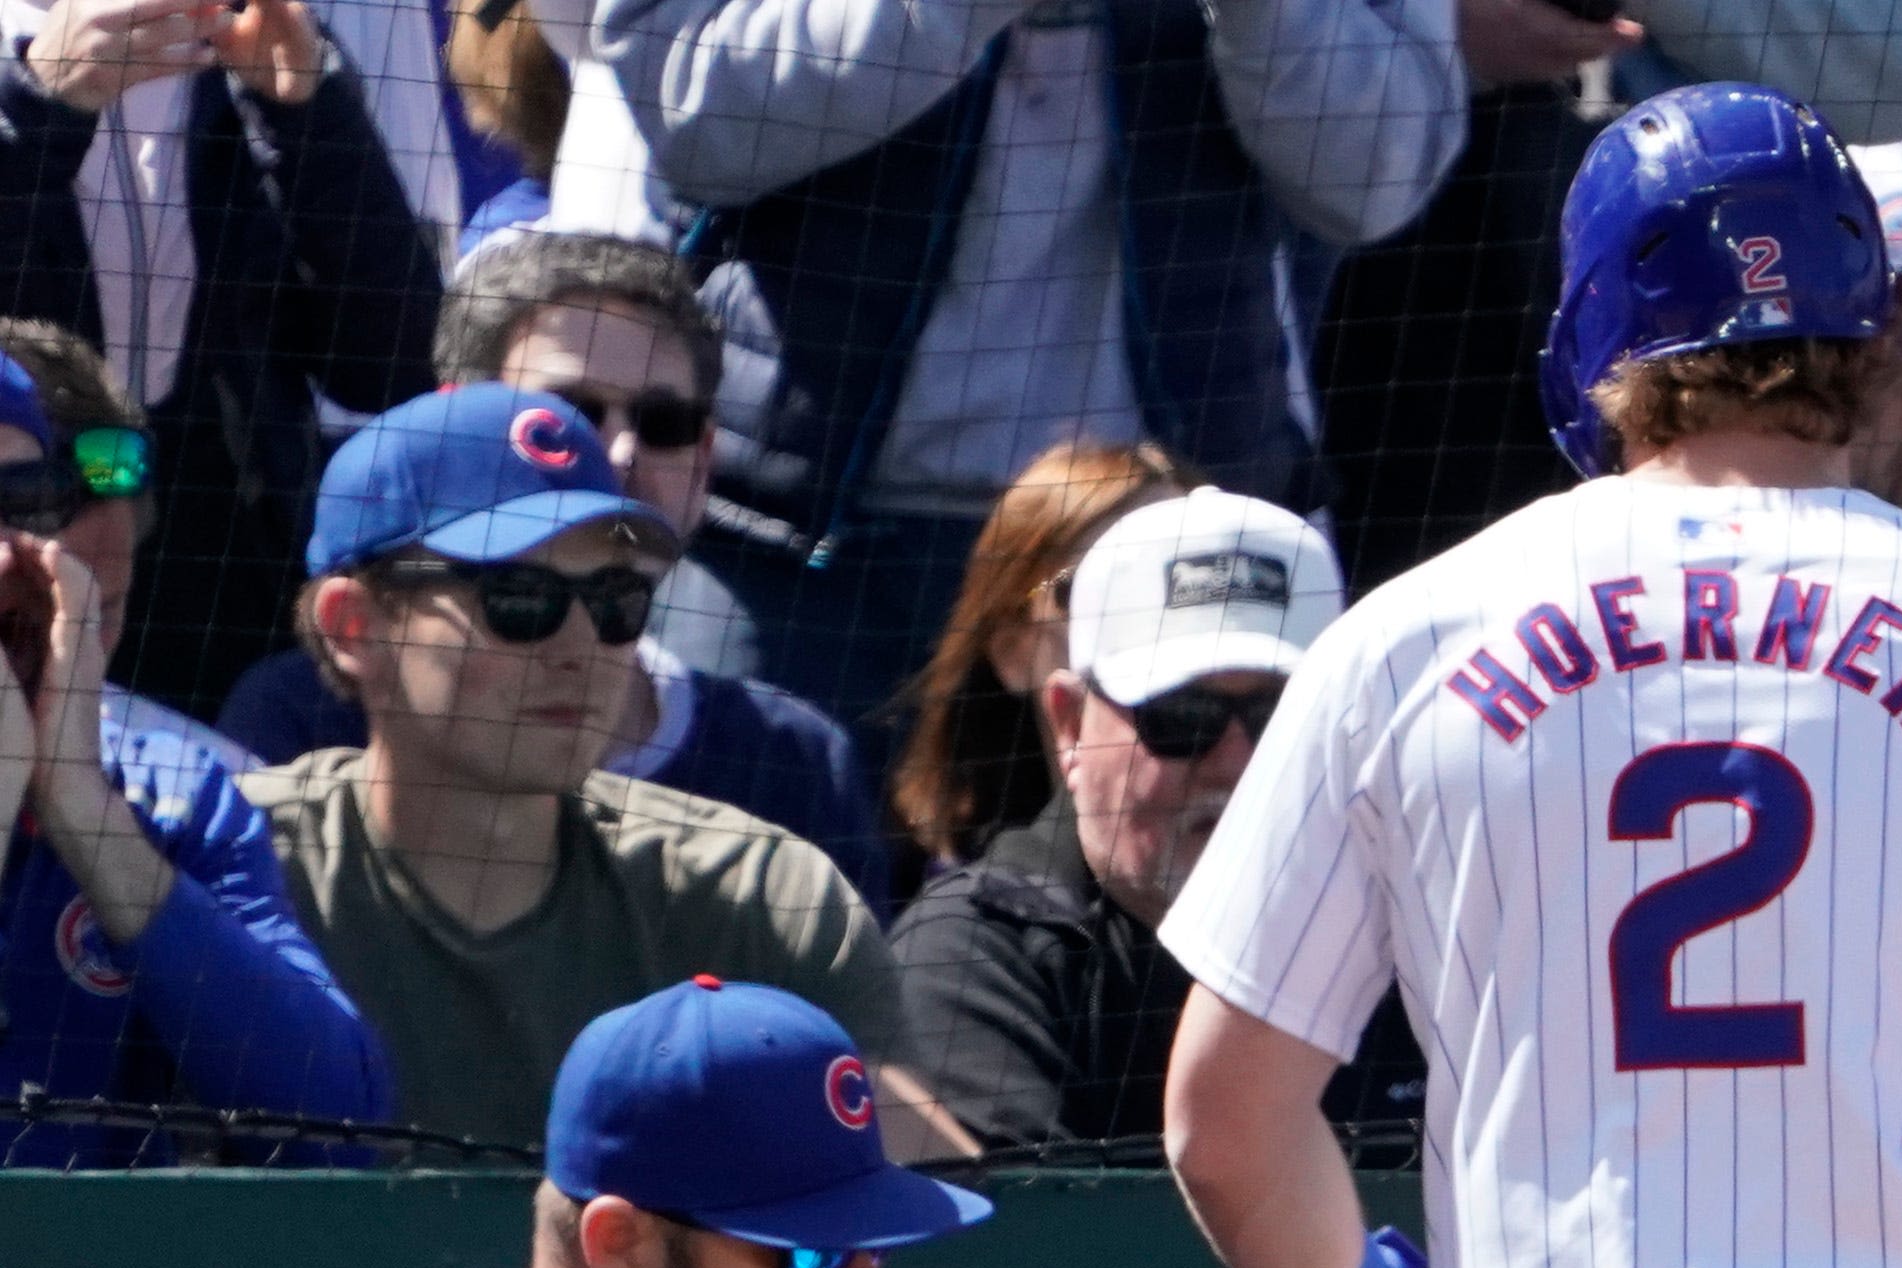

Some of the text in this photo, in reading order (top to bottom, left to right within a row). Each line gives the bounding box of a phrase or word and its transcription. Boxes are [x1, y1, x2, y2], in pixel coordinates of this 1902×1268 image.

[1737, 235, 1786, 294] 2
[509, 407, 579, 471] C
[1608, 741, 1816, 1072] 2
[824, 1054, 873, 1130] C
